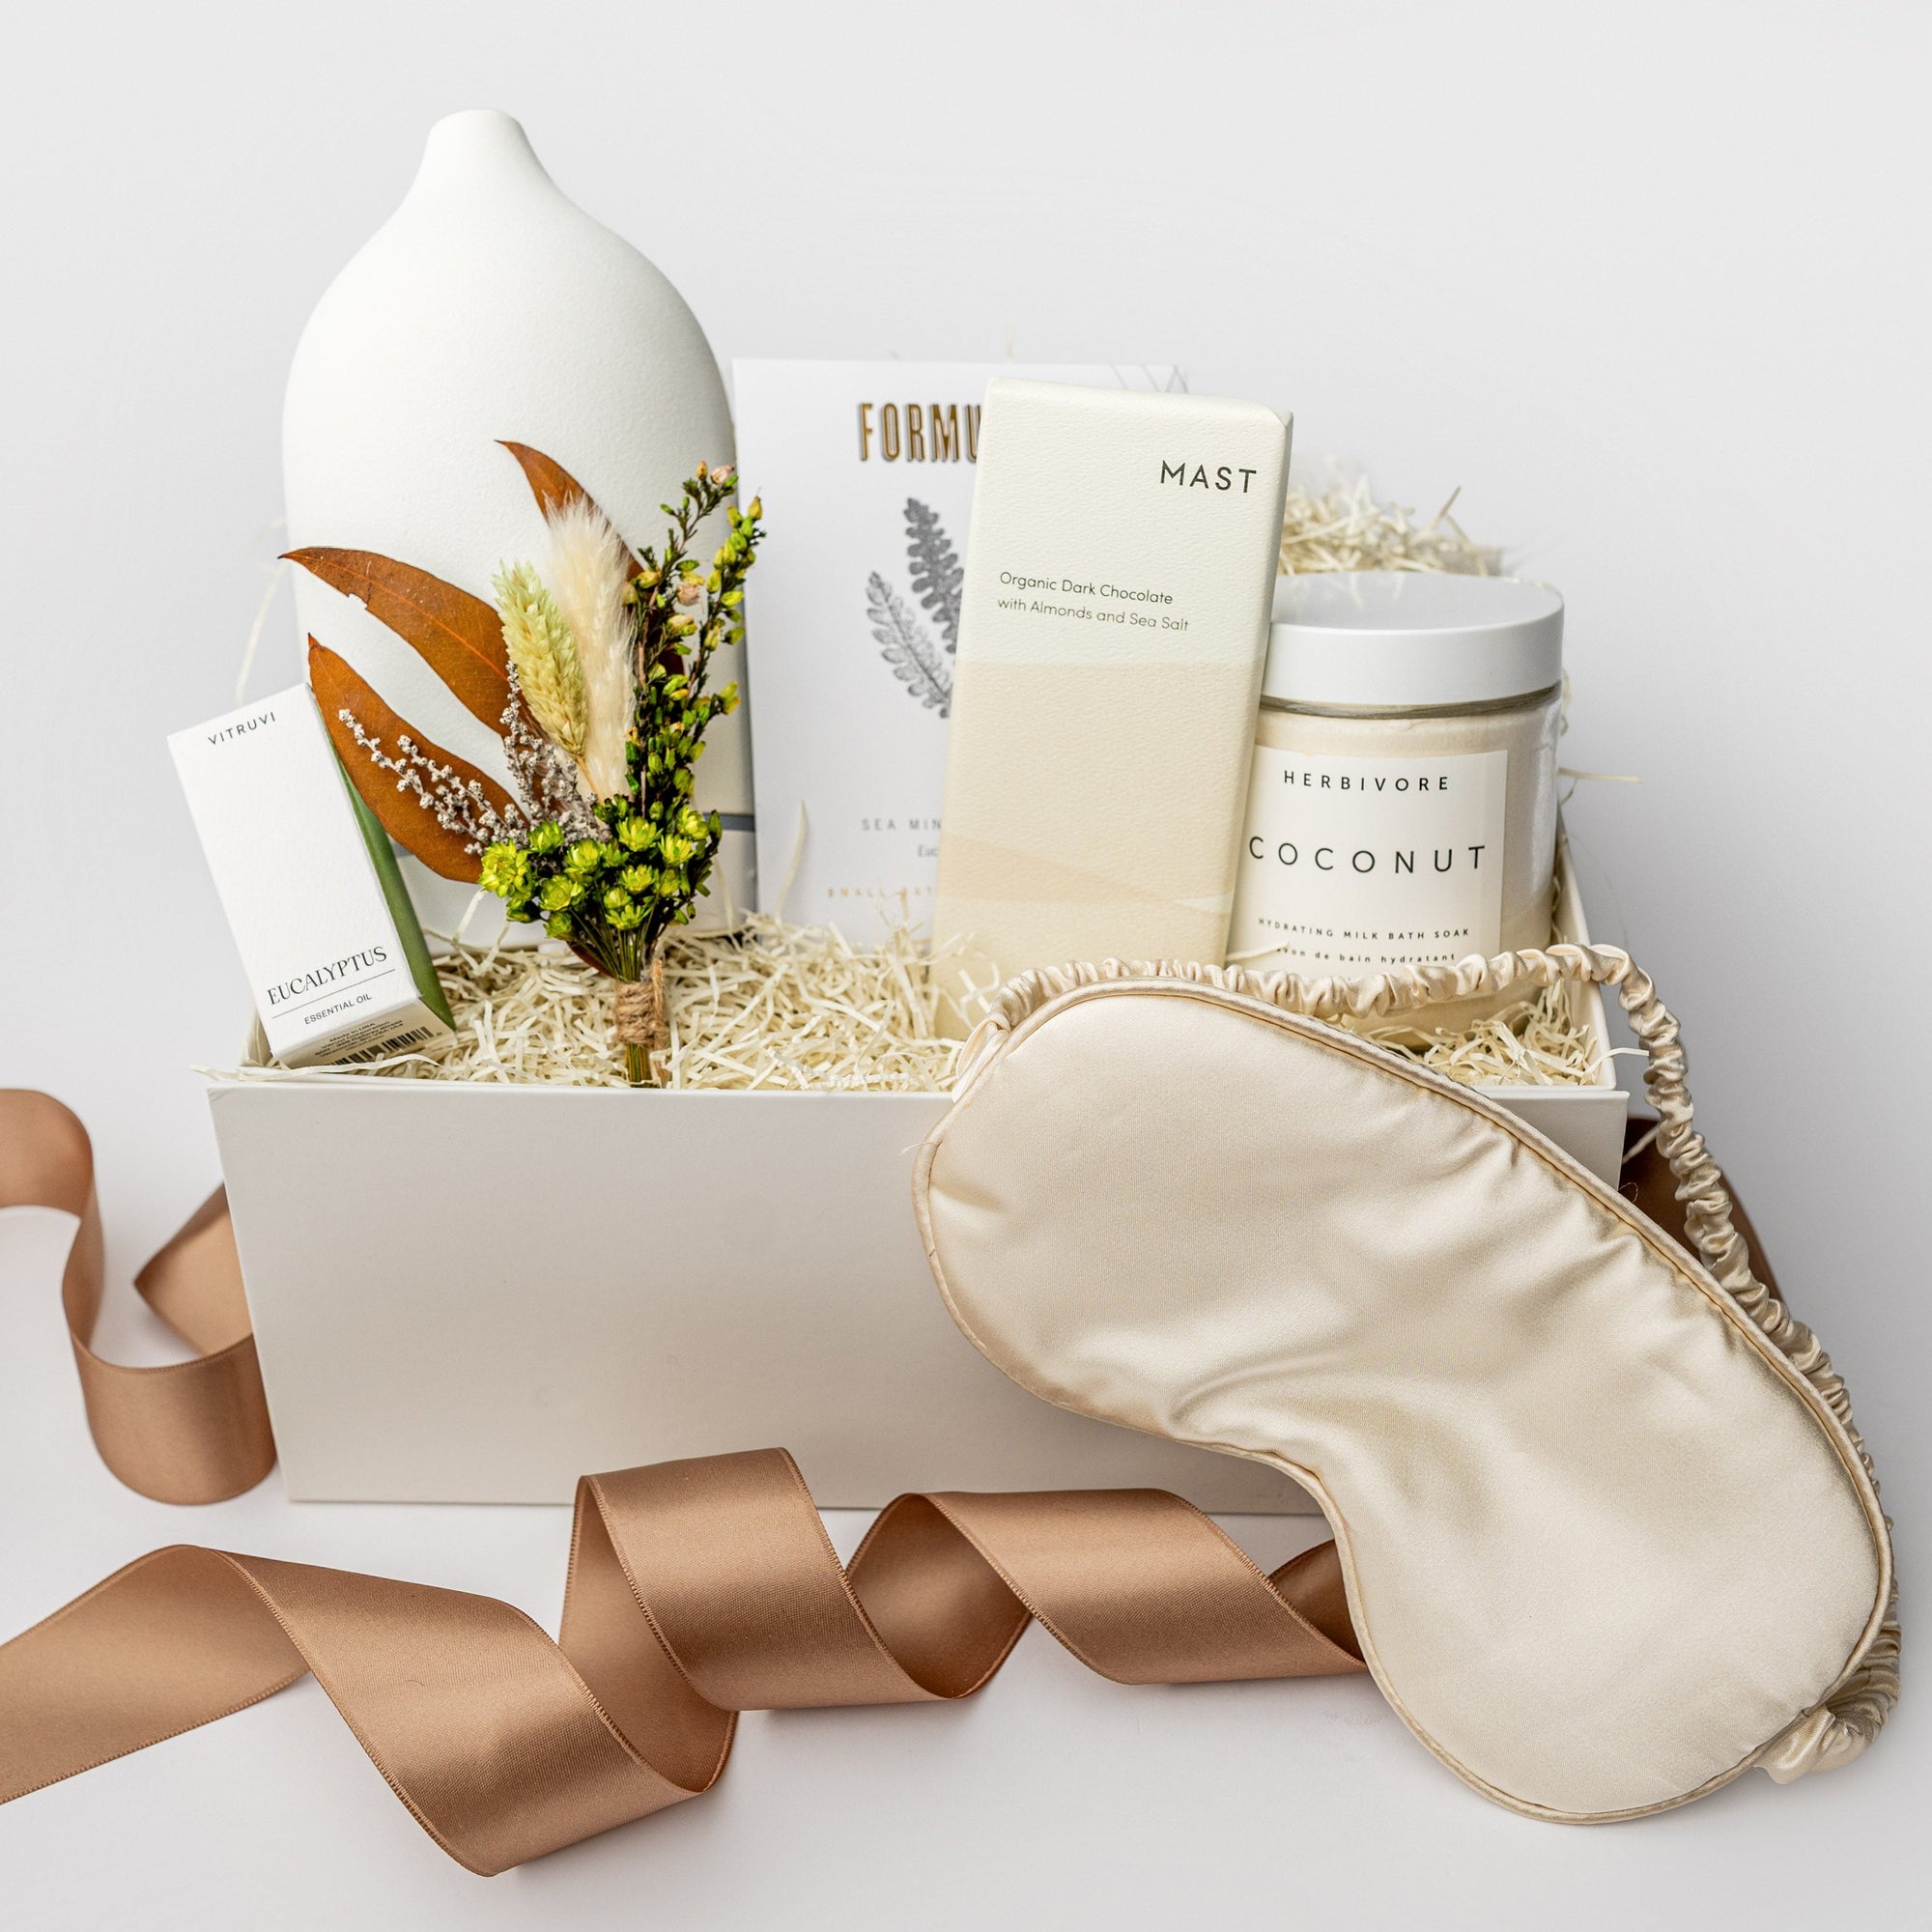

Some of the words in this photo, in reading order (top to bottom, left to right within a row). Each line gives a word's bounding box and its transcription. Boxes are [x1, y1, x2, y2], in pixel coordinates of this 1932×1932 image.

[1160, 460, 1257, 493] MAST
[1000, 571, 1057, 590] Organic
[1062, 579, 1095, 595] Dark
[1099, 584, 1174, 605] Chocolate
[997, 597, 1027, 611] with
[1030, 601, 1093, 619] Almonds
[1096, 611, 1125, 624] and
[1129, 612, 1156, 628] Sea
[1161, 616, 1189, 631] Salt
[208, 711, 275, 745] VITRUVI
[1284, 770, 1448, 792] HERBIVORE
[861, 817, 896, 831] SEA
[1249, 836, 1486, 873] COCONUT
[1258, 918, 1334, 938] HYDRATING
[1343, 930, 1378, 940] MILK
[1388, 931, 1425, 940] BATH
[1435, 927, 1469, 939] SOAK
[1315, 952, 1330, 960] de
[1339, 953, 1371, 963] bain
[1380, 952, 1456, 965] hydratant
[267, 946, 387, 1006] EUCALYPTUS
[304, 1000, 355, 1025] ESSENTIAL
[355, 993, 373, 1004] OIL
